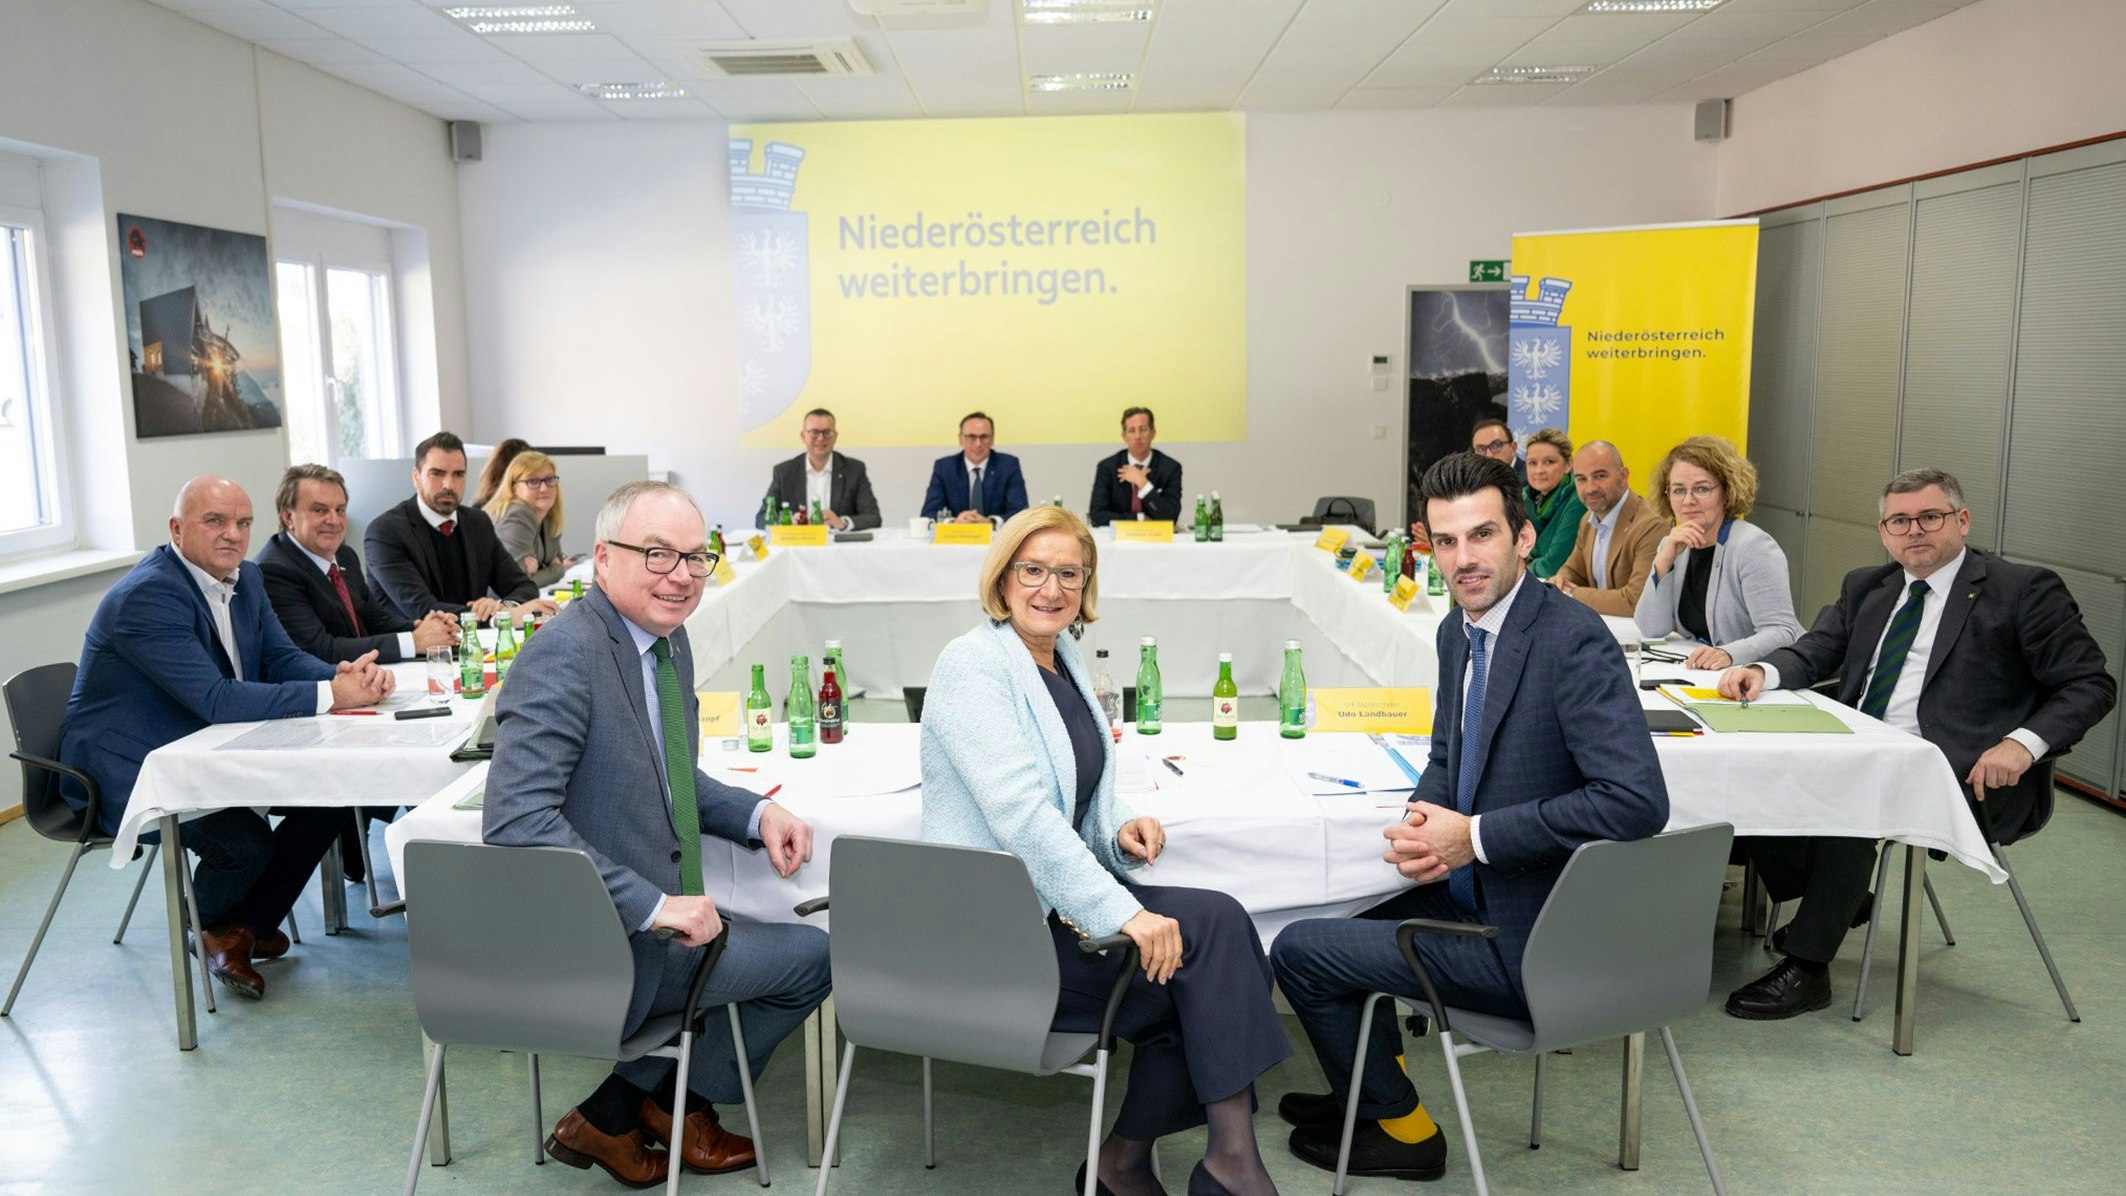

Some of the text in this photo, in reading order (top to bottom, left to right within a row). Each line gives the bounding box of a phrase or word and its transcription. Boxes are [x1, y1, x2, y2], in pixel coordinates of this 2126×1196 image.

[838, 207, 1156, 250] Niederösterreich
[838, 259, 1117, 305] weiterbringen.
[1587, 328, 1725, 342] Niederösterreich
[1587, 345, 1706, 361] weiterbringen.
